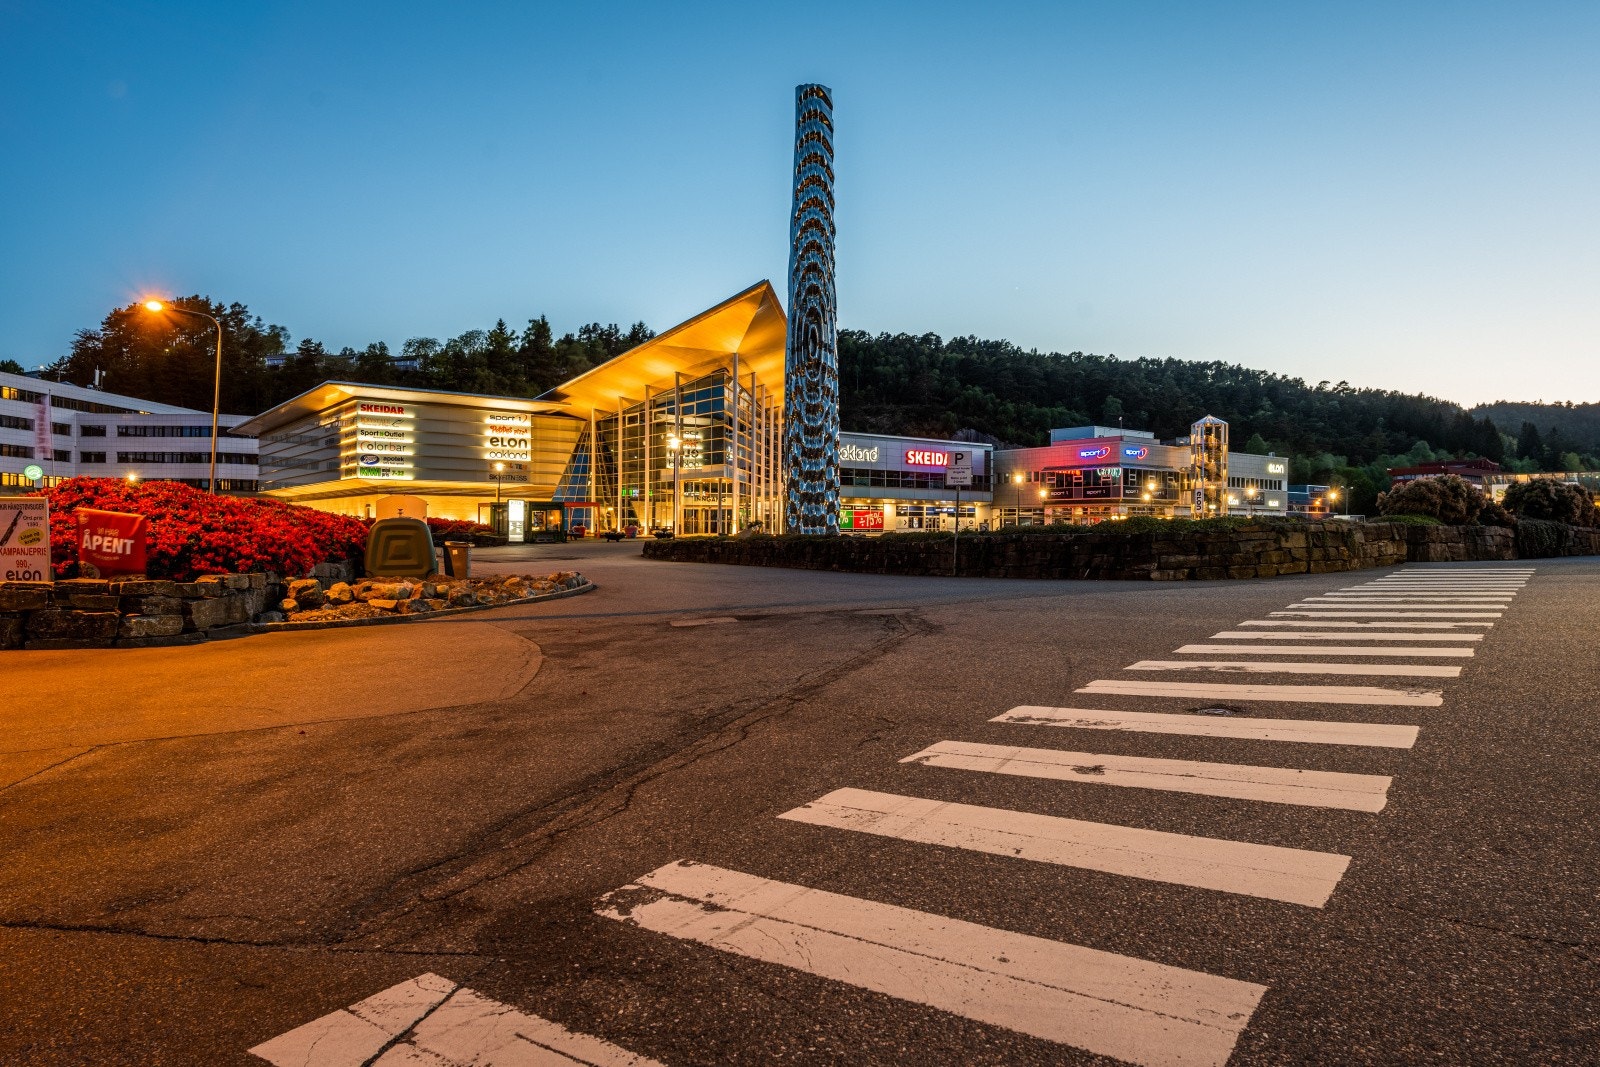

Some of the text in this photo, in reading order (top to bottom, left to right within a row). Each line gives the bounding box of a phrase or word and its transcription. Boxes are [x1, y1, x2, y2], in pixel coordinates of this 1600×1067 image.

[360, 404, 404, 414] SKEIDAR
[360, 441, 406, 451] Colorbar
[490, 450, 527, 459] oakland
[839, 445, 878, 462] akland
[907, 451, 947, 465] SKEID
[955, 453, 964, 465] P
[82, 528, 135, 555] ÅPENT
